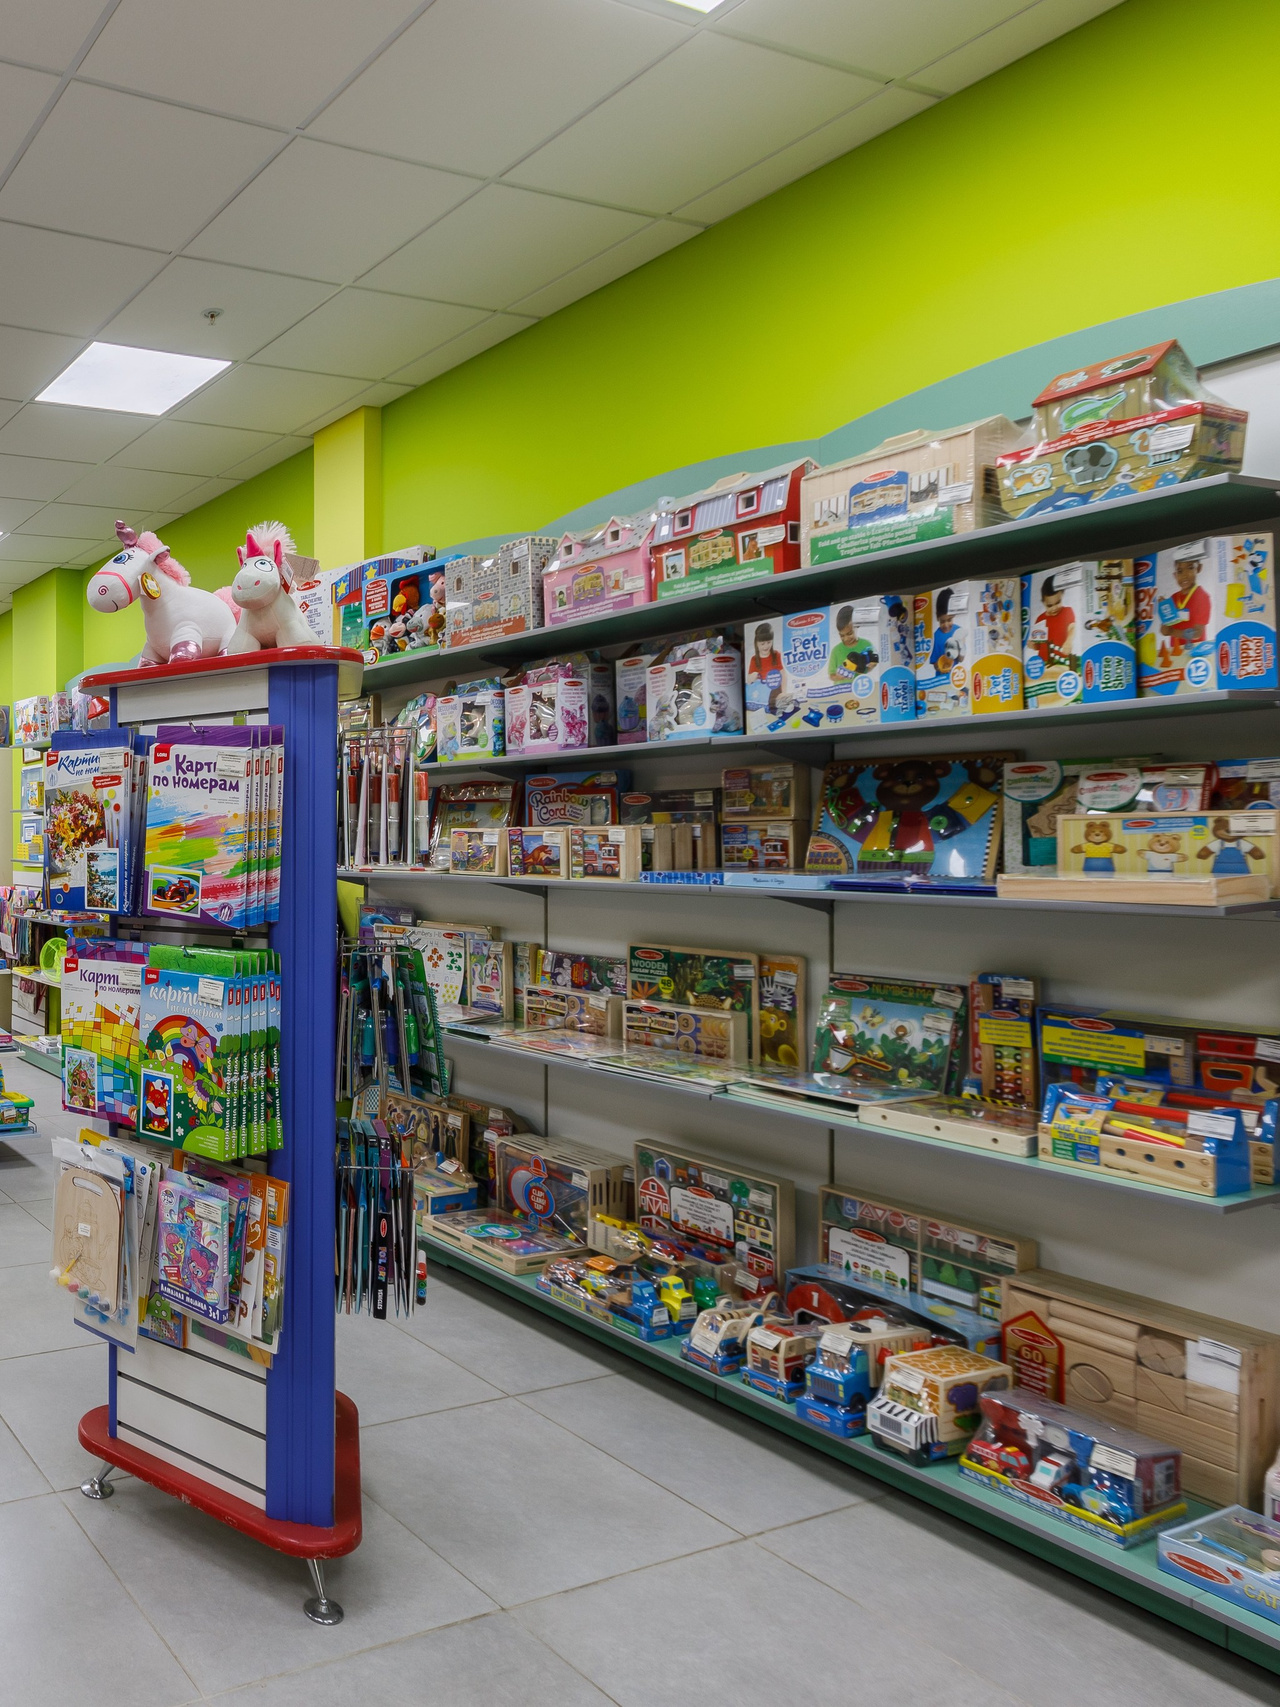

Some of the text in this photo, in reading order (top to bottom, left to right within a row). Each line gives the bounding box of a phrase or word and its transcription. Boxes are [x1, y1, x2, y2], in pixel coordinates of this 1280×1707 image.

[791, 633, 819, 652] Pet
[783, 643, 827, 666] Travel
[1238, 634, 1253, 679] Puppy
[1253, 637, 1266, 676] School
[953, 669, 965, 679] 26
[1100, 656, 1113, 691] Horse
[1113, 656, 1125, 690] Show
[1190, 663, 1207, 676] 12
[858, 679, 869, 688] 15
[57, 754, 100, 775] Карти
[153, 775, 240, 793] по номерам
[531, 788, 589, 807] Rainbow
[538, 804, 567, 822] Cord
[631, 959, 668, 970] WOODEN
[661, 979, 671, 987] 48
[181, 1006, 222, 1019] номерам
[532, 1188, 545, 1198] CLAP!
[534, 1202, 544, 1211] TAP!
[378, 1265, 387, 1283] ART
[811, 1291, 818, 1307] 1
[1021, 1347, 1043, 1363] 60
